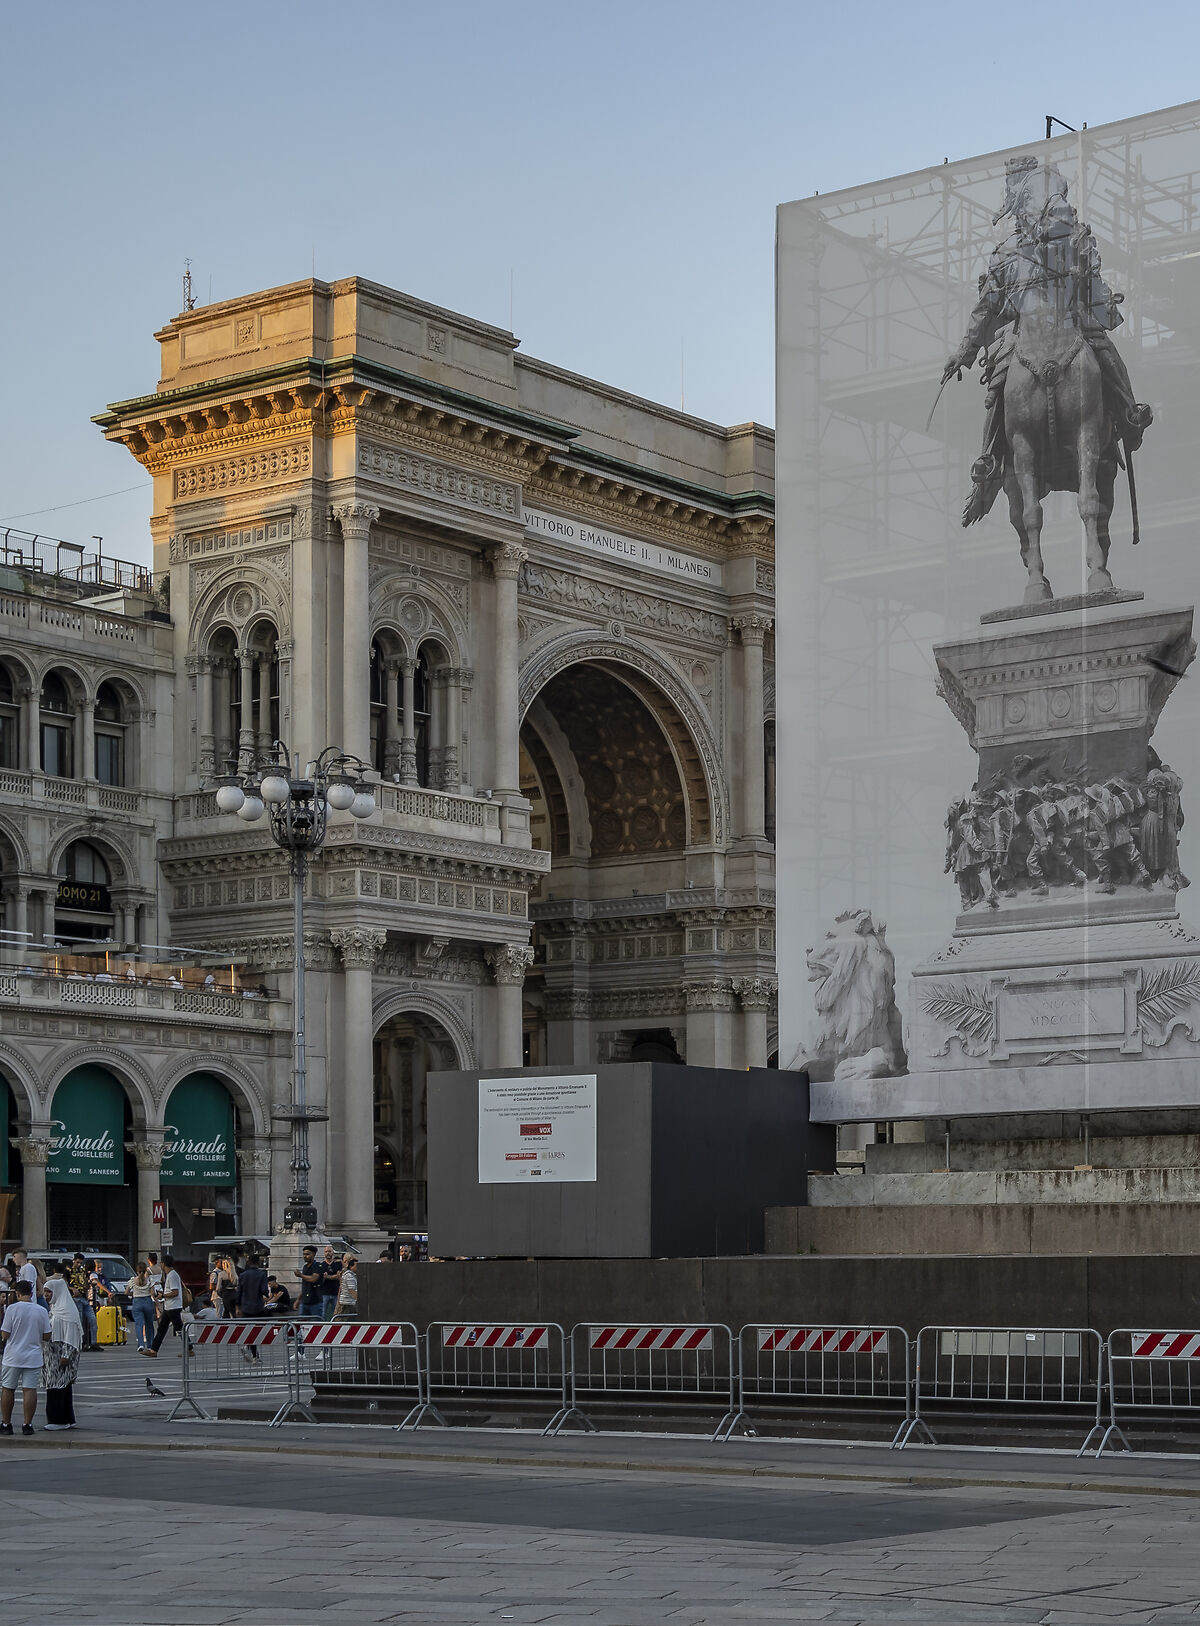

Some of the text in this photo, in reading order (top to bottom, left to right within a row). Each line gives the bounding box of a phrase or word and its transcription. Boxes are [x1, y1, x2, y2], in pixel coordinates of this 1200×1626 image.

[524, 513, 574, 537] VITTORIO
[579, 530, 637, 556] EMANUELE
[667, 555, 711, 578] MILANESI
[90, 889, 101, 902] 21
[71, 1150, 114, 1159] GIOIELLERIE
[185, 1154, 226, 1162] GIOIELLERIE
[89, 1168, 120, 1176] SANREMO
[154, 1205, 164, 1218] M
